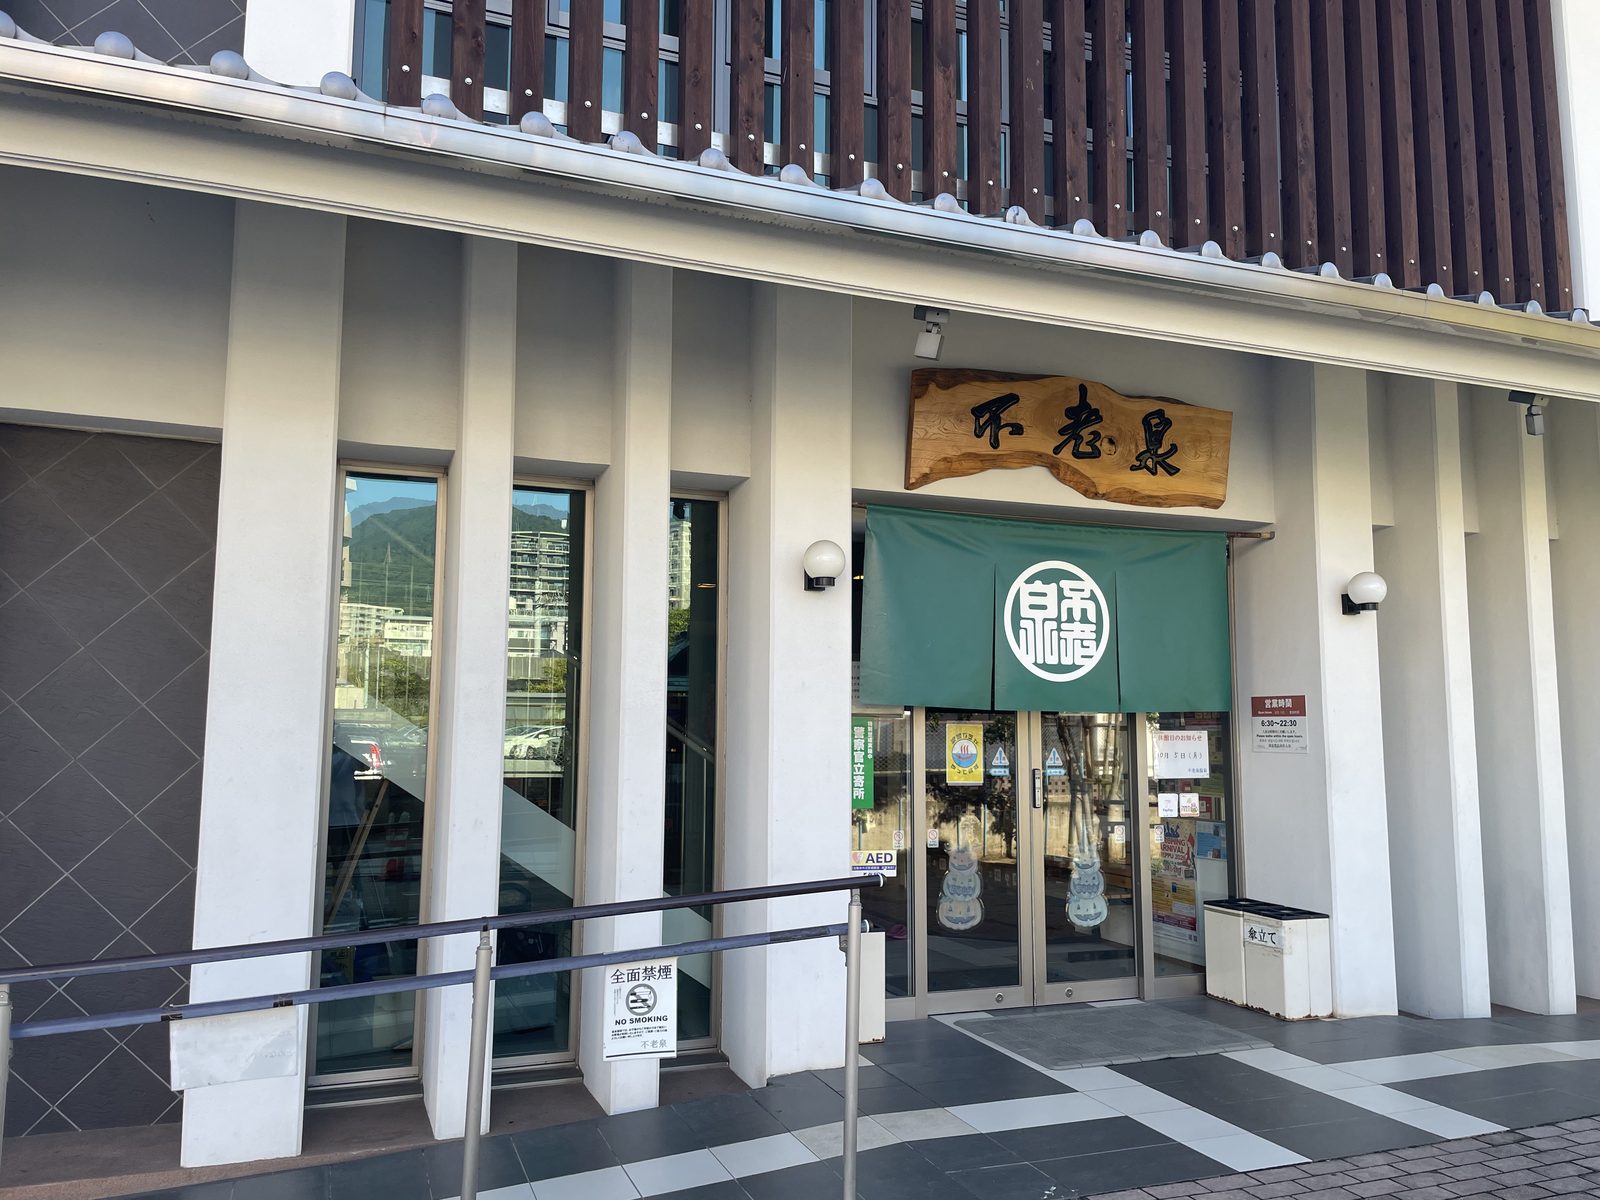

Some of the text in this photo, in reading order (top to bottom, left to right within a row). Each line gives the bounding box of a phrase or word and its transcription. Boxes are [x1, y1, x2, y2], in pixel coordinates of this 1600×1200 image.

[970, 383, 1181, 476] 不老泉
[1264, 698, 1293, 709] 営業時間
[853, 726, 865, 800] 警察官立寄所
[865, 852, 893, 864] AED
[1248, 927, 1276, 944] 傘立て
[610, 964, 673, 984] 全面禁煙
[629, 1015, 668, 1024] SMOKING
[641, 1039, 667, 1048] 不老泉
